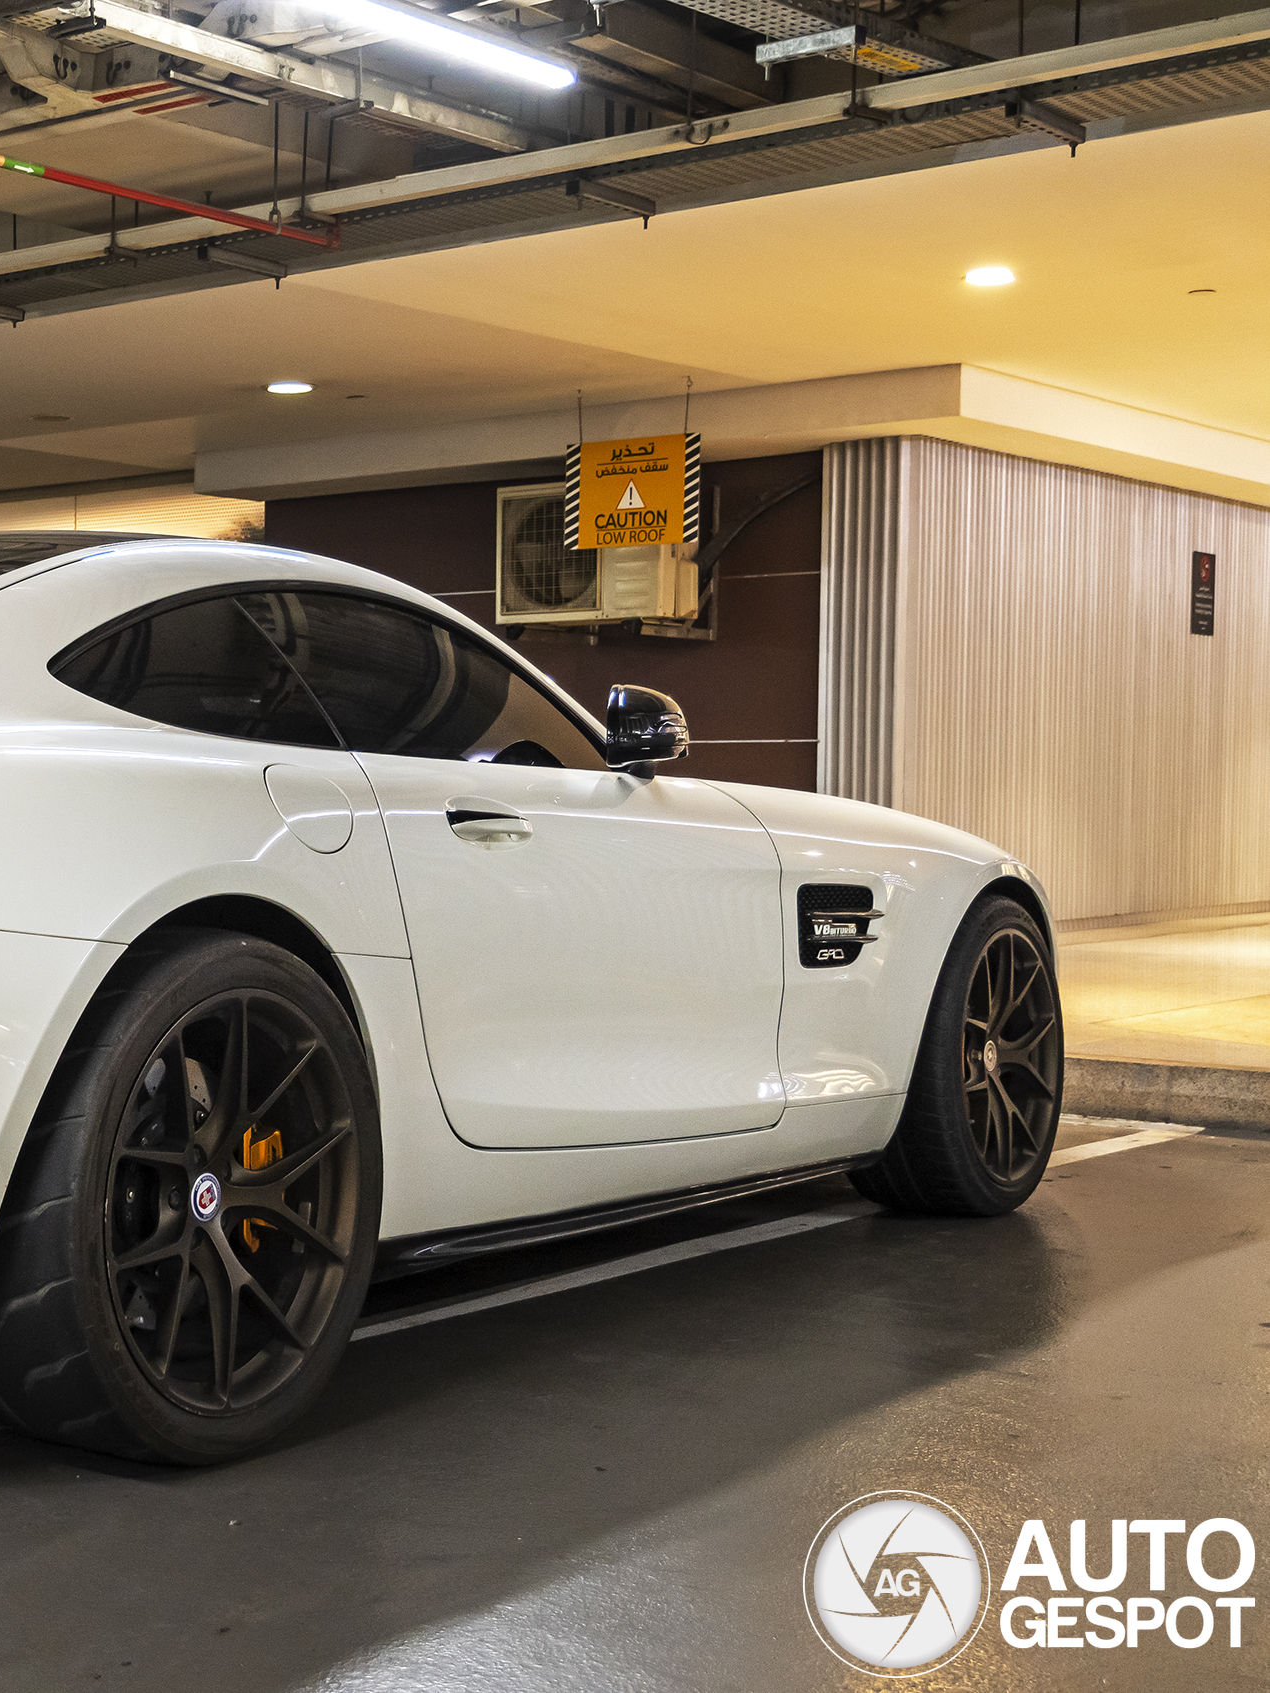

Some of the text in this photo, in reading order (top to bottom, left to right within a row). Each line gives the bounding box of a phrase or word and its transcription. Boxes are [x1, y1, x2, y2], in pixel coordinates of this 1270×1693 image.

[610, 442, 655, 461] تحذير
[596, 462, 669, 478] سقف منخفض
[595, 510, 667, 529] CAUTION
[596, 529, 665, 545] LOW ROOF
